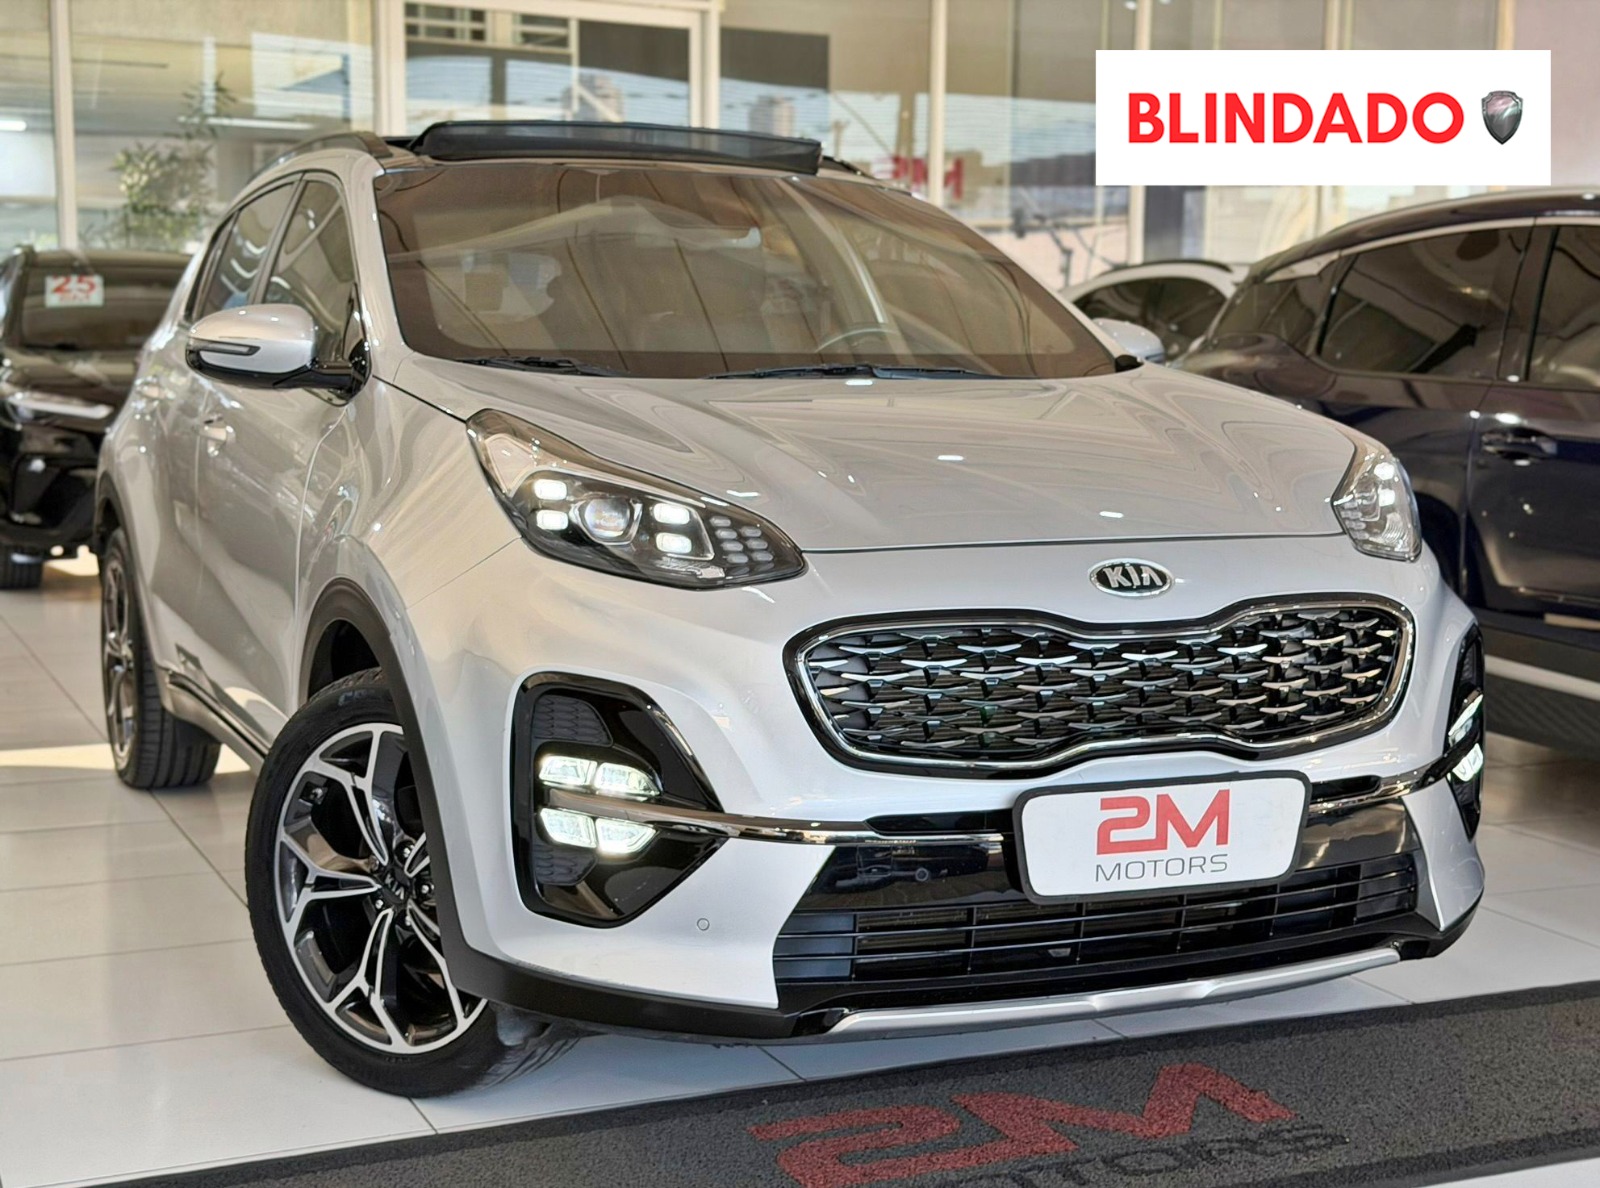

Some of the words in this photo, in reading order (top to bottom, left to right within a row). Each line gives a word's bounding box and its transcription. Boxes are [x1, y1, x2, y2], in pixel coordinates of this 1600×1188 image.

[1102, 563, 1163, 588] KIA
[1096, 789, 1230, 855] 2M
[1095, 853, 1228, 882] MOTORS
[746, 1062, 1298, 1188] 2M
